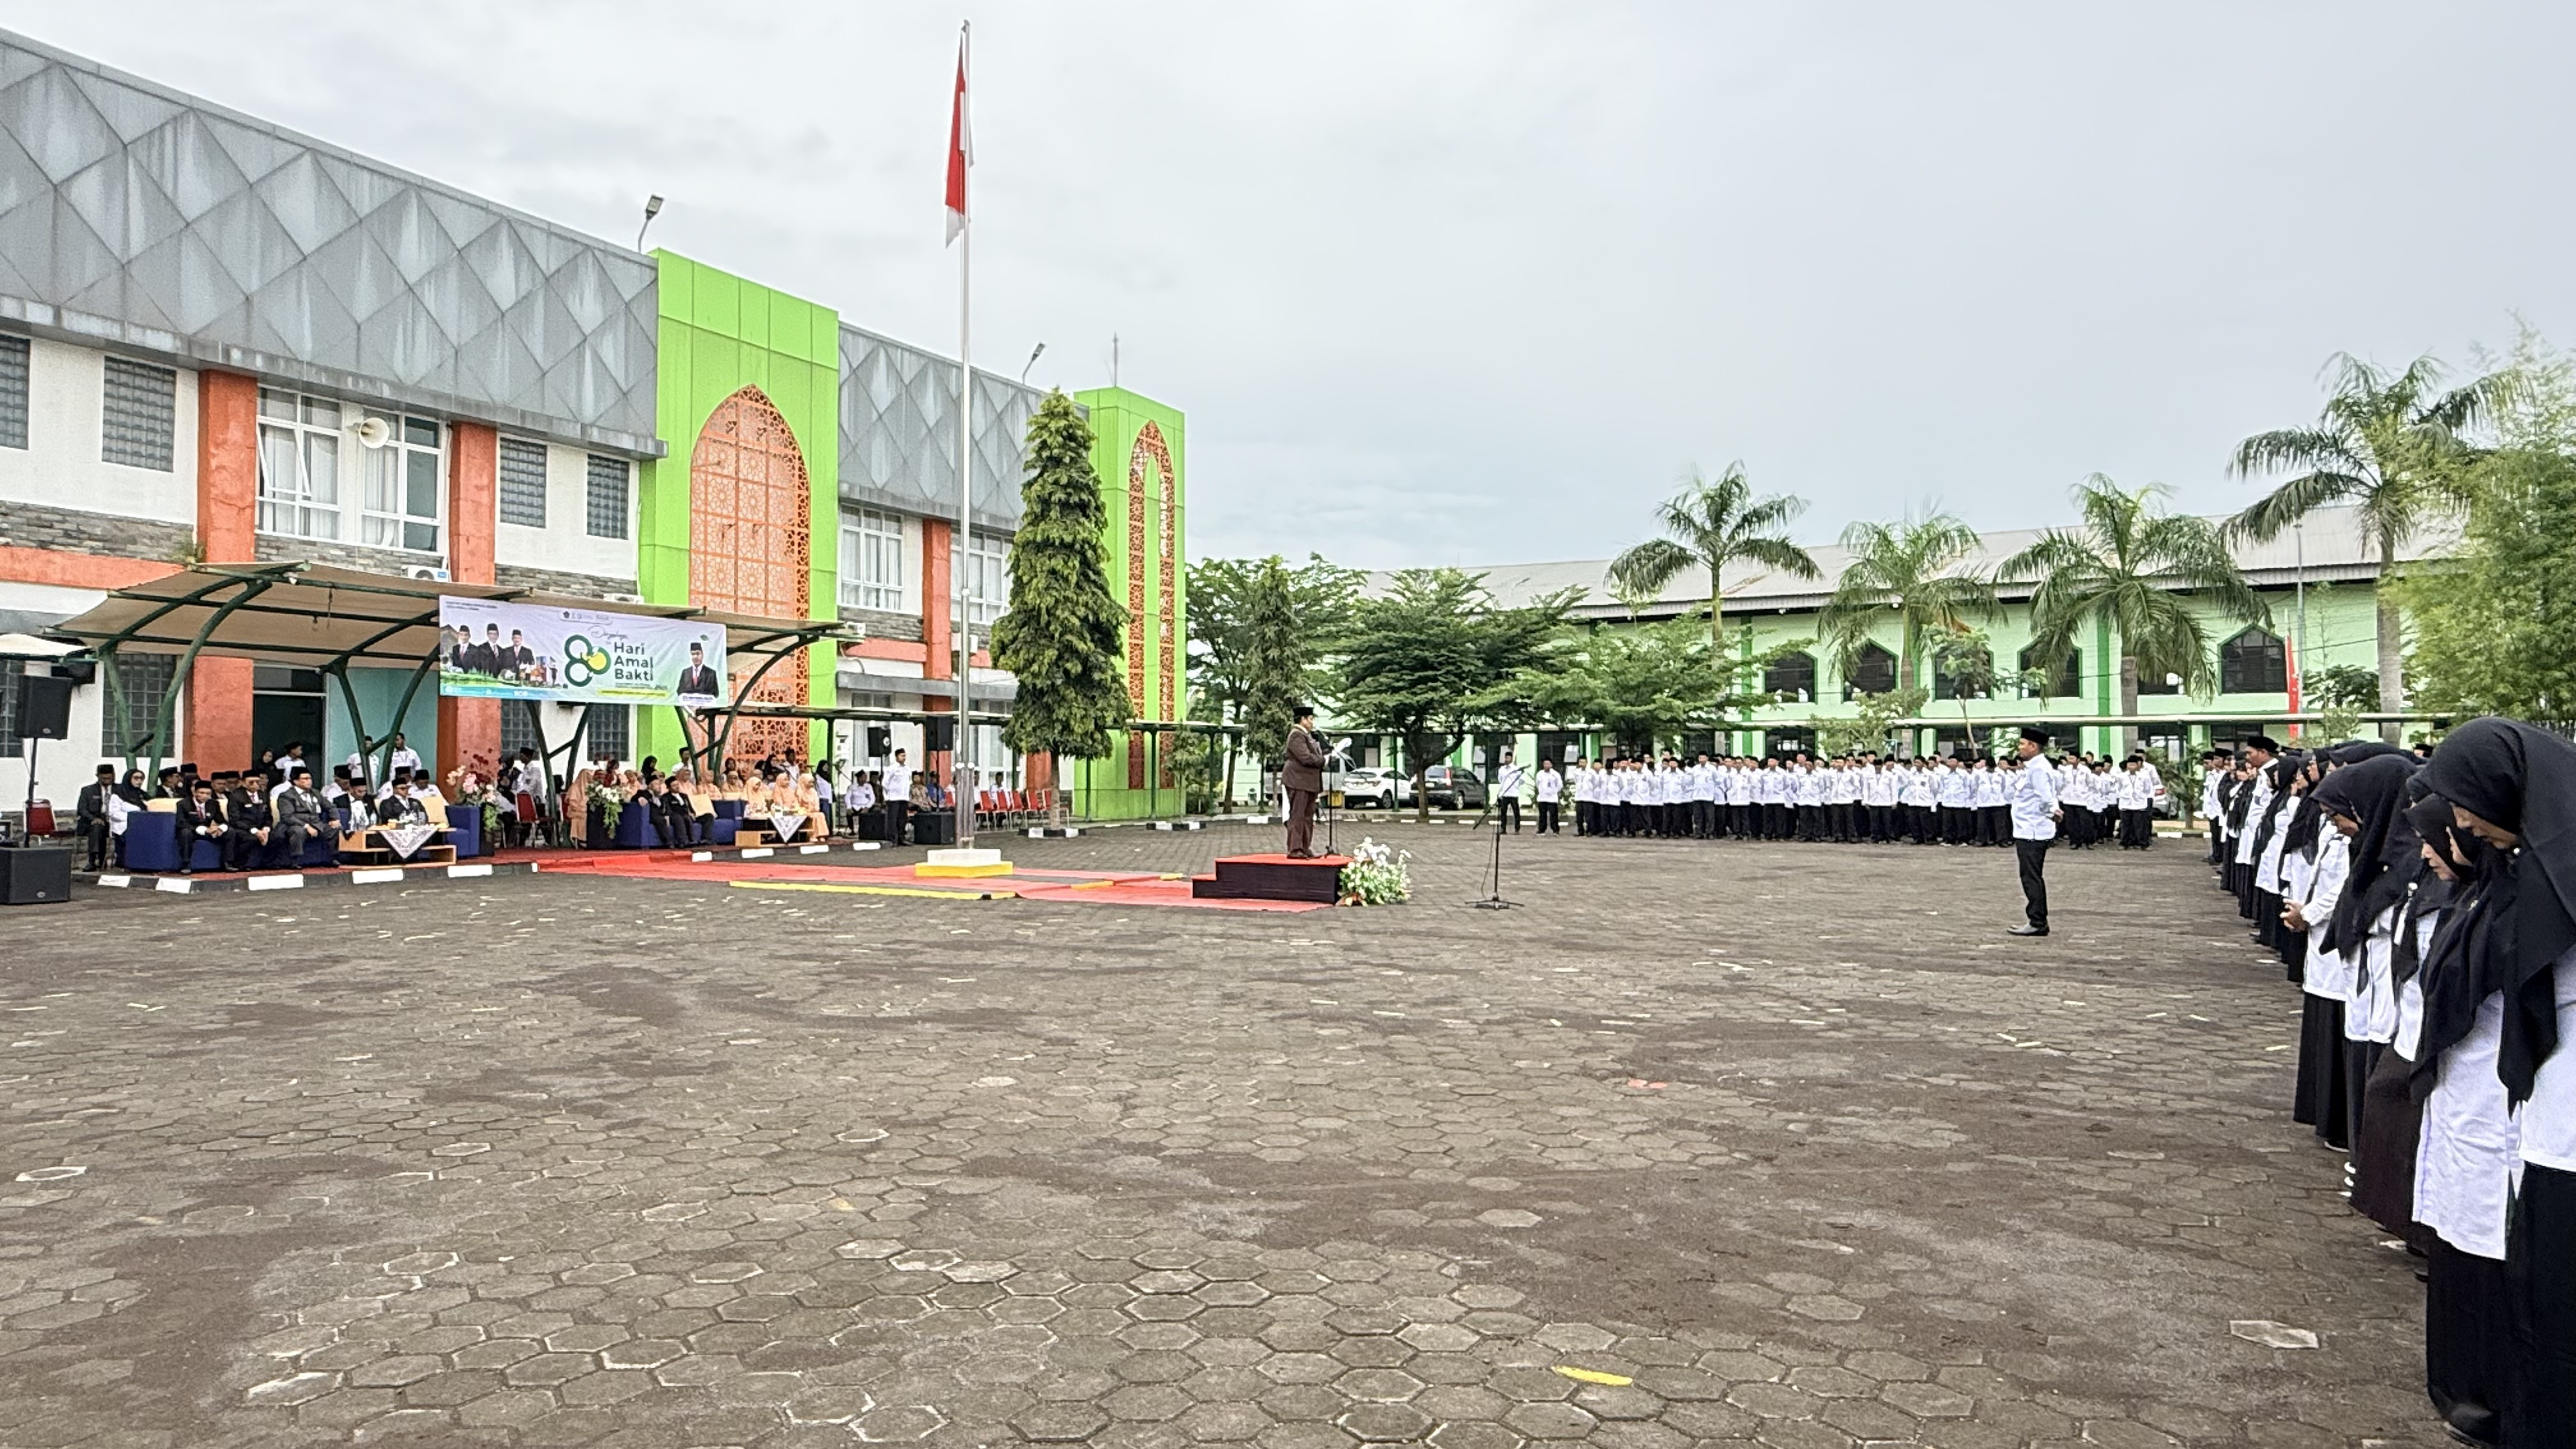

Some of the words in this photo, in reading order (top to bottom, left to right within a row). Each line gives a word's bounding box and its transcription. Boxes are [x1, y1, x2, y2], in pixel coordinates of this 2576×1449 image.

[614, 641, 645, 655] Hari
[613, 655, 654, 668] Amal
[615, 668, 654, 681] Bakti
